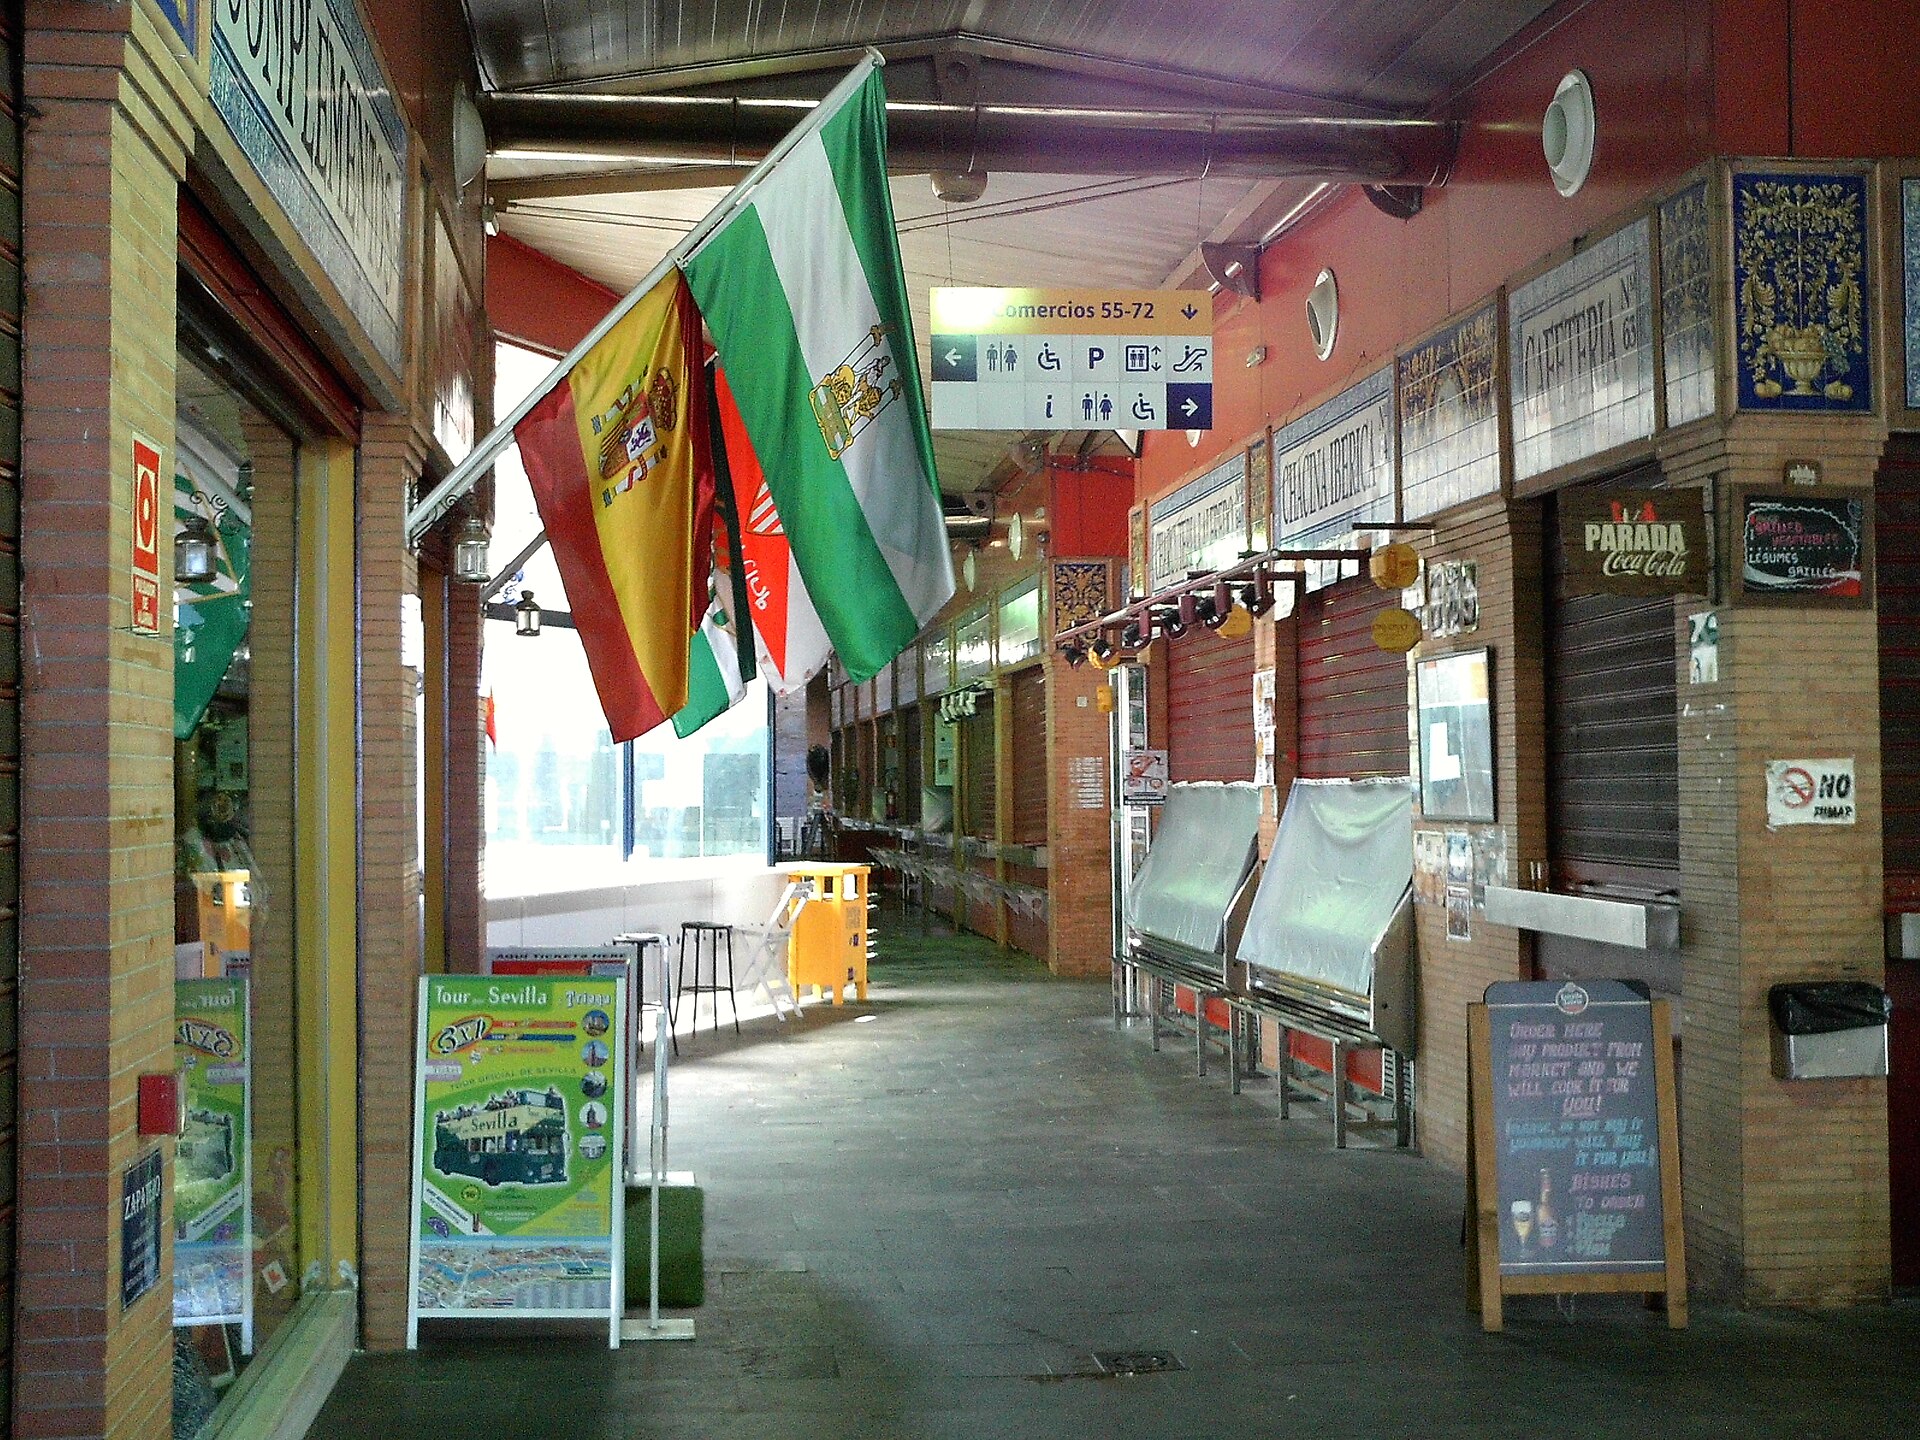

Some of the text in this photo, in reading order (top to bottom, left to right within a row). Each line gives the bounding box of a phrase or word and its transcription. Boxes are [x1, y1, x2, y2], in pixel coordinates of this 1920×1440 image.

[992, 301, 1154, 319] Comercios 55-72
[1584, 523, 1687, 551] PARADA
[1819, 773, 1851, 799] NO
[436, 986, 471, 1004] Tour
[488, 986, 548, 1005] Sevilla
[1509, 1022, 1604, 1039] ORDER HERE
[471, 1110, 518, 1133] Sevilla
